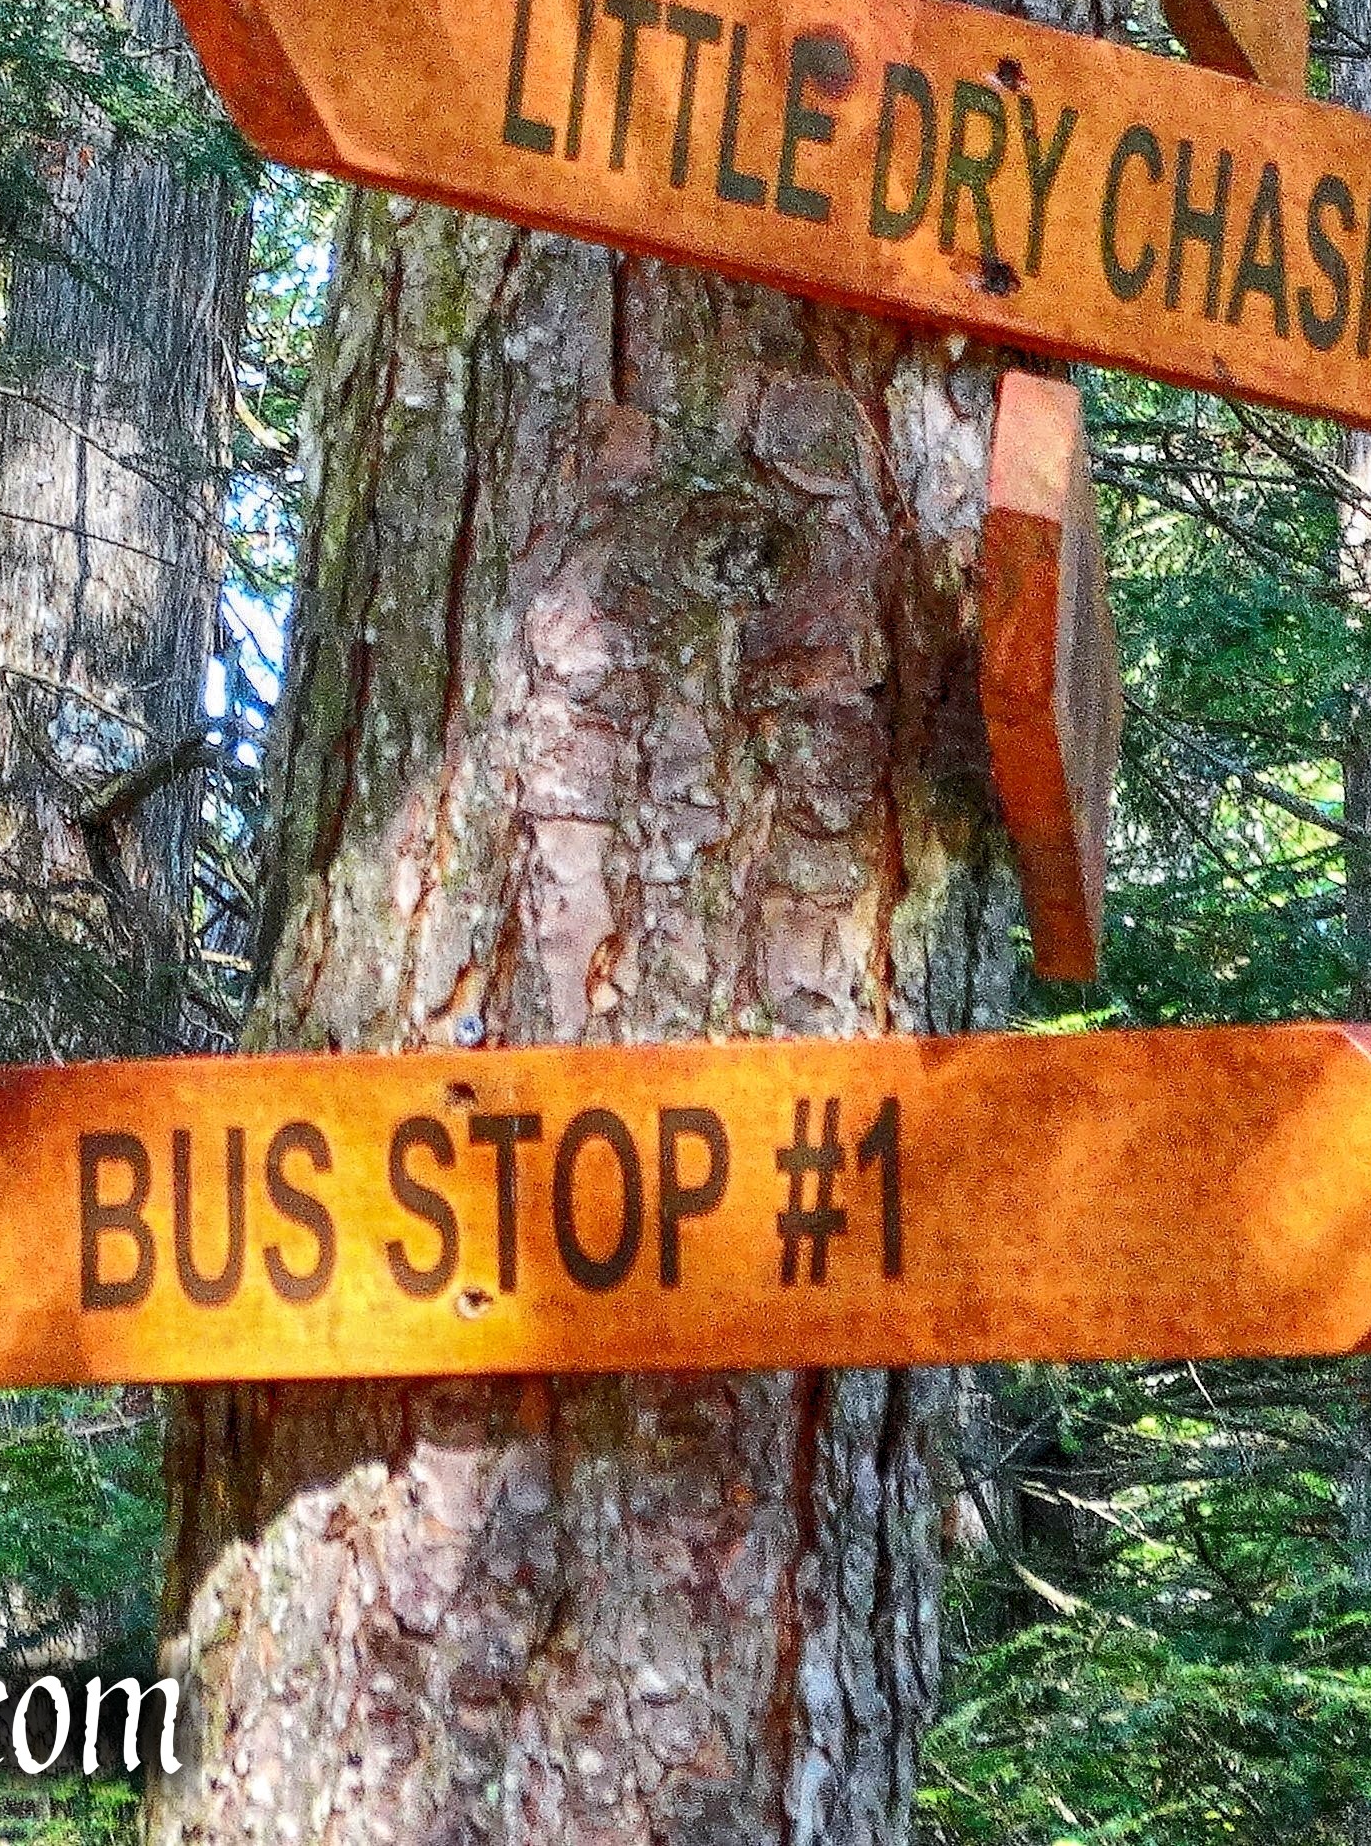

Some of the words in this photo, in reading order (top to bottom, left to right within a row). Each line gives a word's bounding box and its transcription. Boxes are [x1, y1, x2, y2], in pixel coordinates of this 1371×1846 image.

[870, 63, 1078, 278] DRY
[78, 1121, 337, 1310] BUS
[386, 1106, 730, 1295] STOP
[776, 1096, 903, 1286] #1
